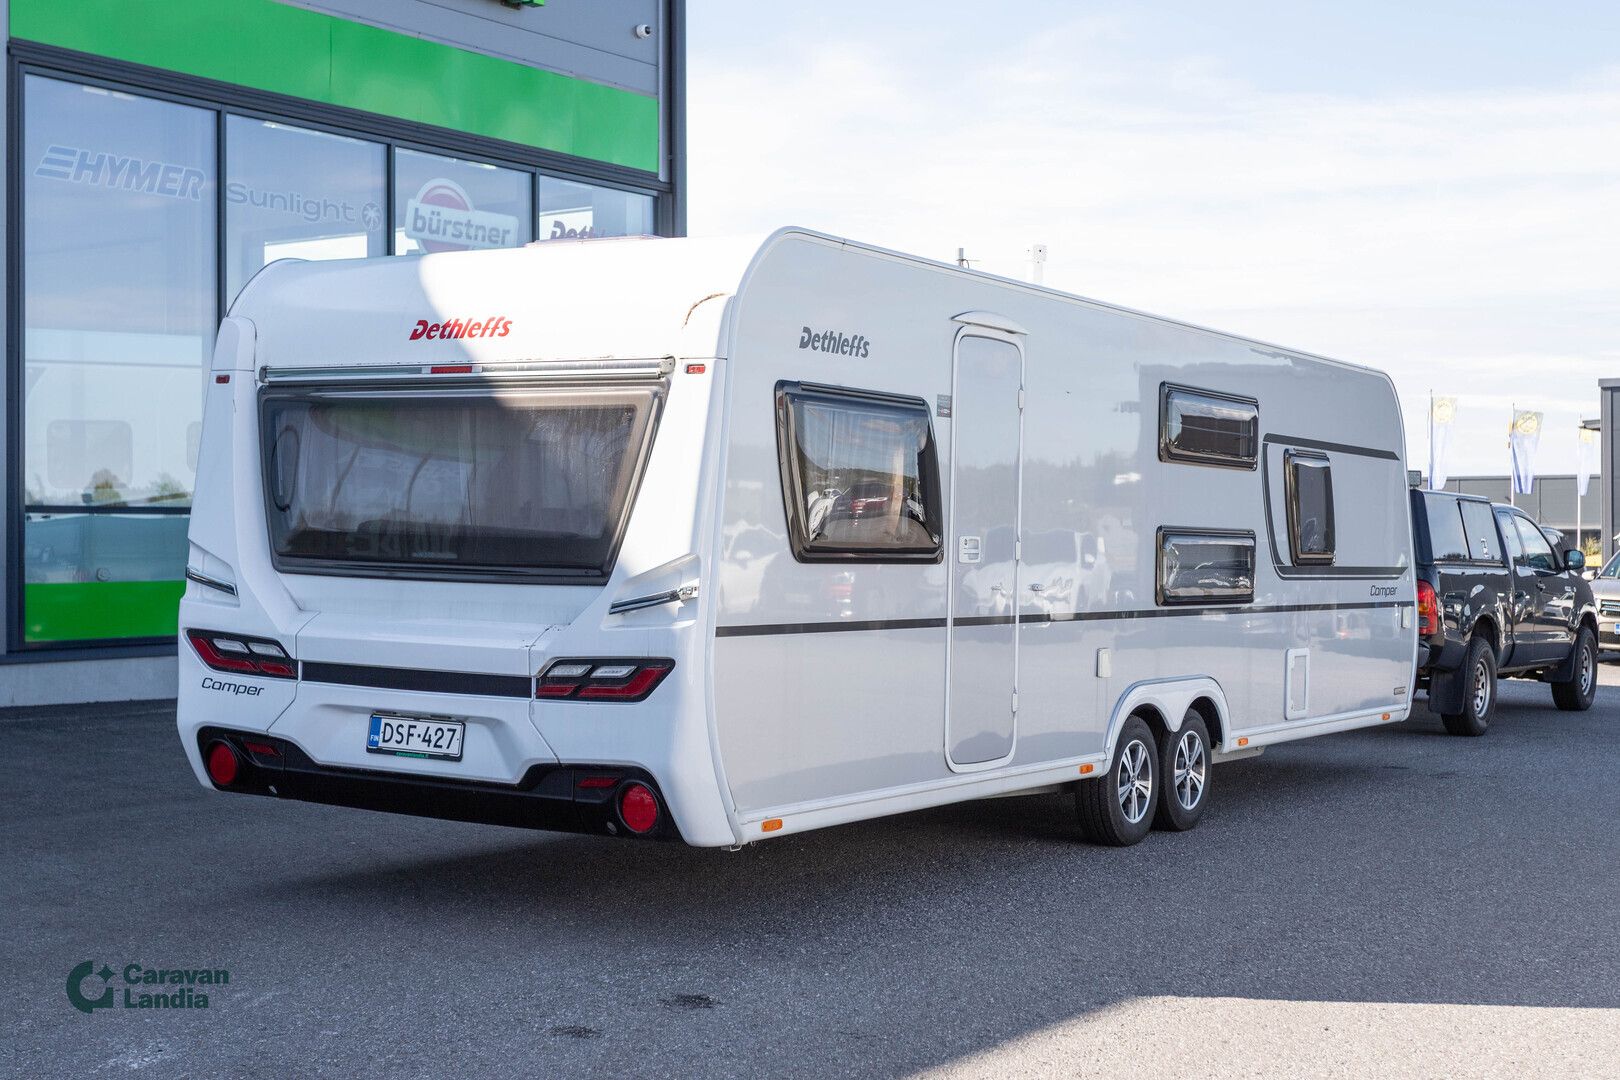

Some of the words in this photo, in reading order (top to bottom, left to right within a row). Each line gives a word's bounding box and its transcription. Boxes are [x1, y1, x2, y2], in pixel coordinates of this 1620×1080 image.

[226, 182, 356, 222] Sunlight
[412, 207, 512, 246] bürstner
[408, 315, 513, 341] Dethleffs
[799, 326, 870, 359] Dethleffs
[1369, 584, 1398, 598] Camper
[201, 677, 265, 697] Camper
[381, 722, 457, 750] DSF-427
